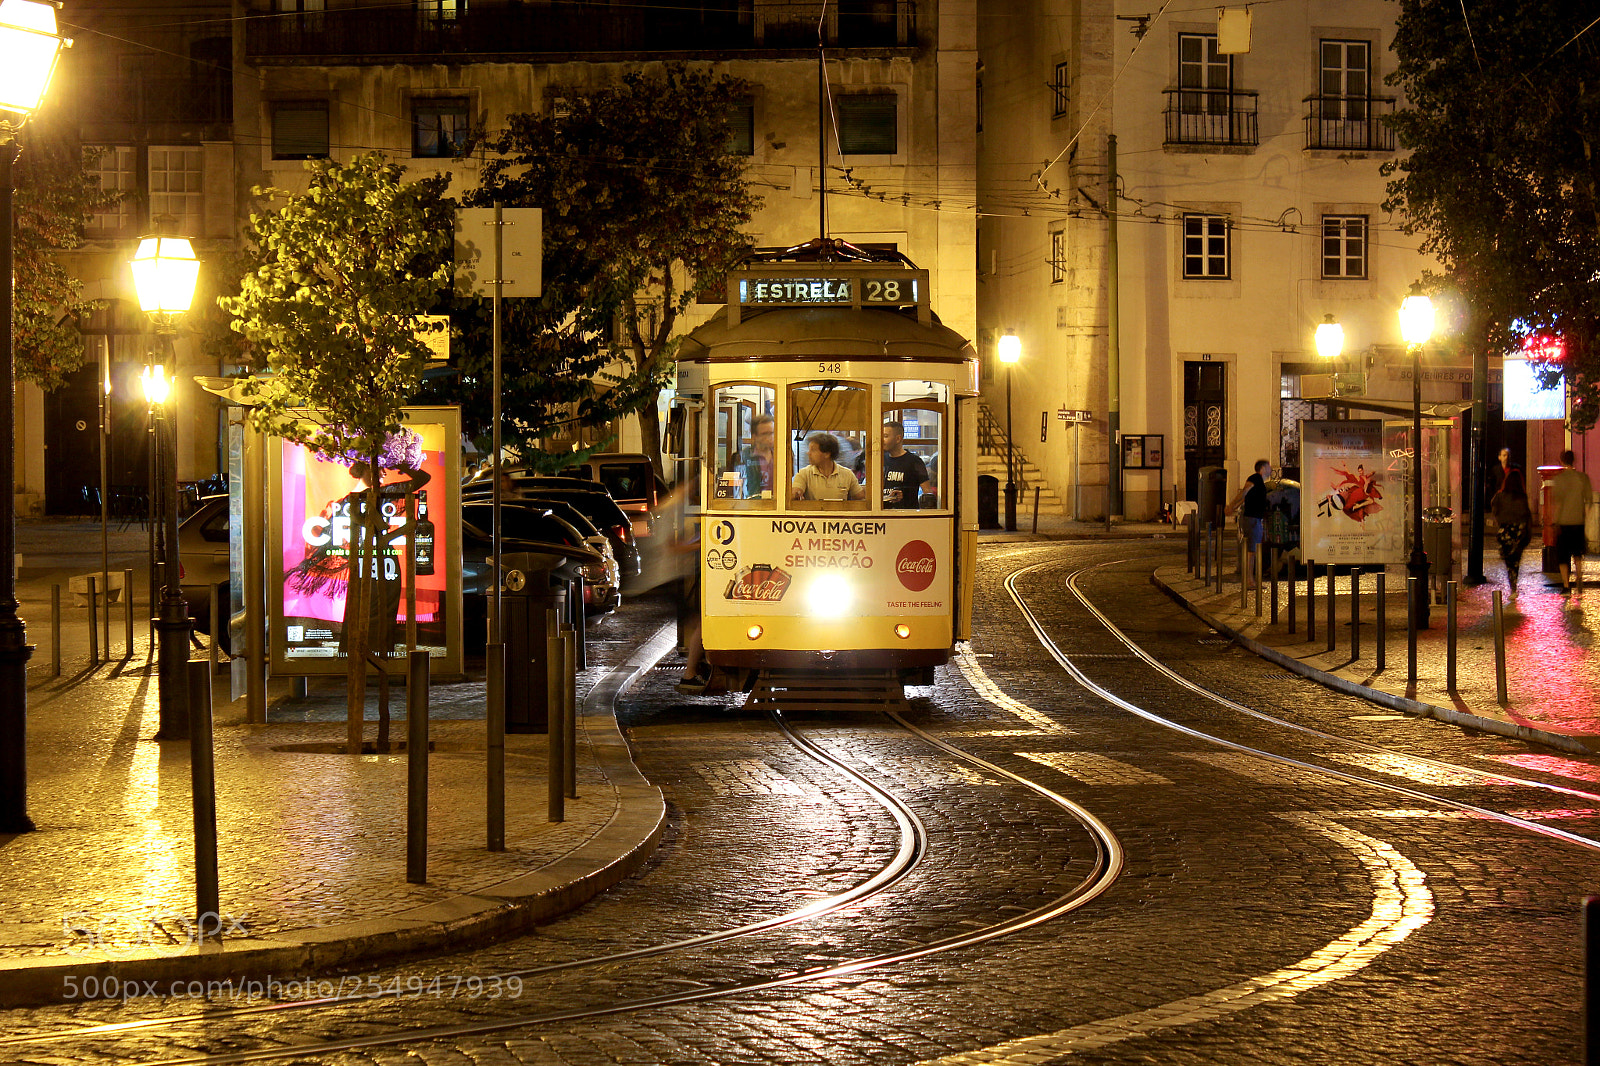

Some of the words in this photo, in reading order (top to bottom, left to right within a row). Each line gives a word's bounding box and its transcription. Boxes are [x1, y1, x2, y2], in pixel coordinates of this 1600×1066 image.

[757, 282, 849, 299] ESTRELA
[866, 280, 901, 302] 28
[818, 362, 841, 374] 548
[717, 490, 727, 498] 05
[302, 516, 407, 547] CRZ
[771, 520, 817, 534] NOVA
[822, 521, 886, 535] IMAGEM
[790, 537, 803, 551] A
[808, 538, 867, 552] MESMA
[784, 552, 874, 570] SENSAÇÃO
